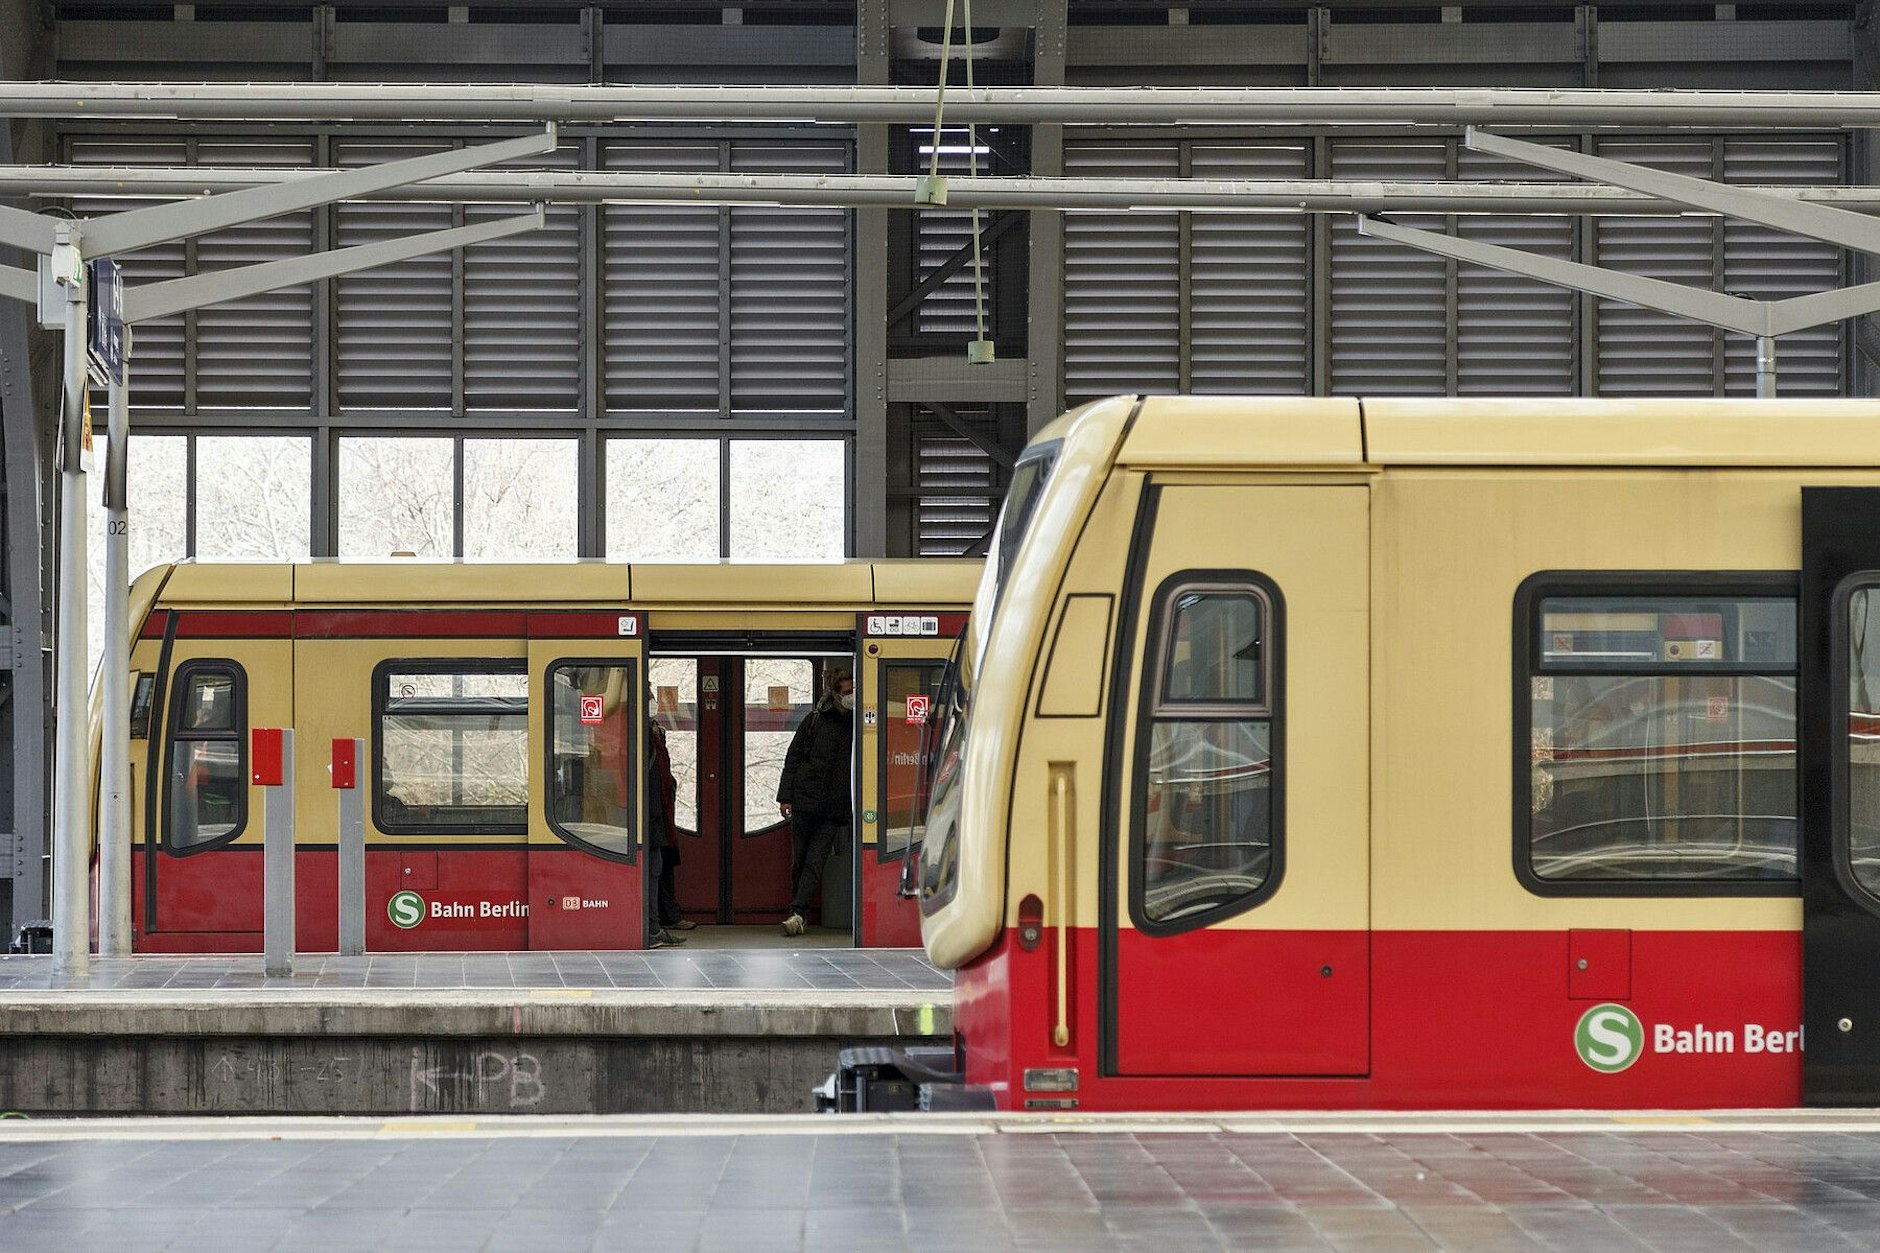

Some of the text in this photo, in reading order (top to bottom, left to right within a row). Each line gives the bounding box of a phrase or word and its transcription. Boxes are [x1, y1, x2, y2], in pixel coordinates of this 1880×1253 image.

[109, 520, 126, 535] 02
[395, 895, 529, 925] S Bahn Berlin
[563, 897, 609, 910] DB BAHN
[1588, 1011, 1632, 1065] S
[1654, 1024, 1735, 1053] Bahn
